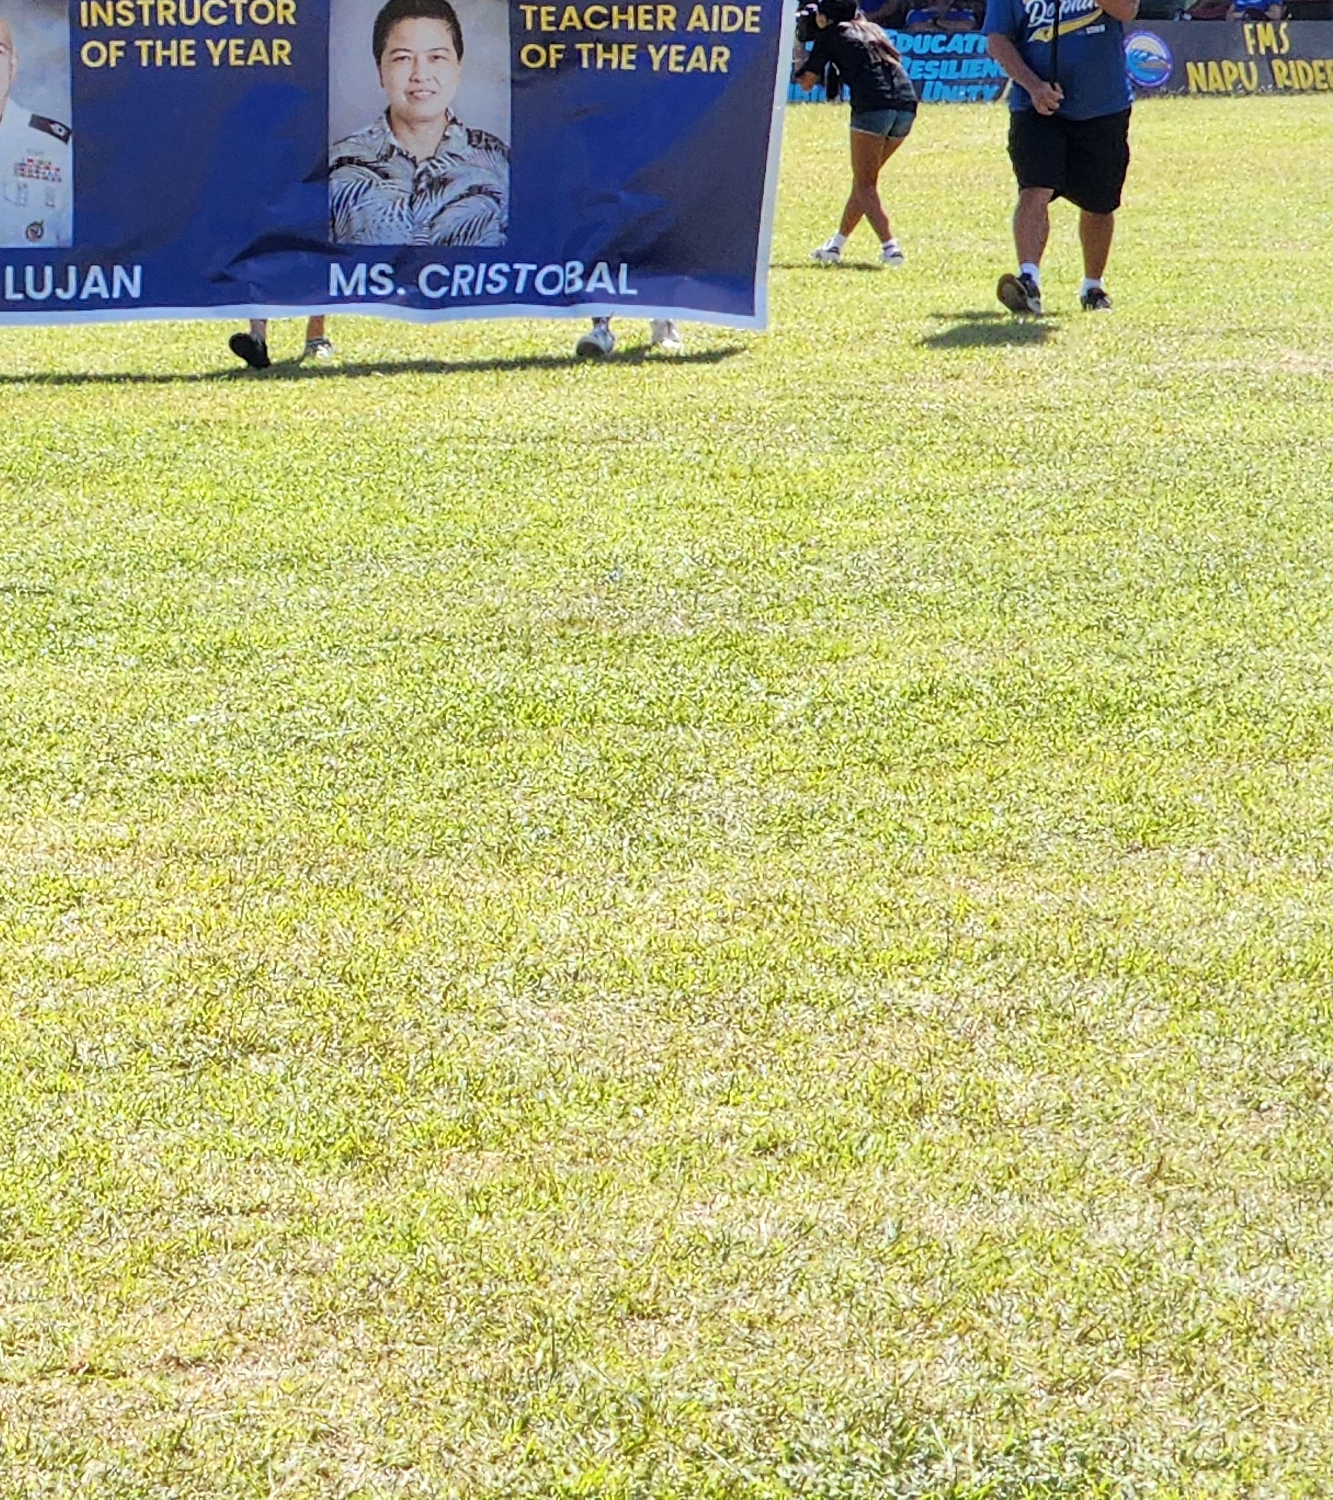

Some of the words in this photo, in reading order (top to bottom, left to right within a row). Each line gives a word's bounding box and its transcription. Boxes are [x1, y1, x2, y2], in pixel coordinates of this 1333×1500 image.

[520, 4, 677, 34] TEACHER
[686, 4, 762, 35] AIDE
[80, 40, 126, 68] OF
[135, 40, 195, 68] THE
[205, 38, 293, 67] YEAR
[1242, 21, 1291, 57] FMS
[520, 43, 565, 70] OF
[576, 43, 638, 71] THE
[647, 44, 731, 74] YEAR
[1185, 59, 1260, 94] NAPU
[5, 264, 143, 299] LUJAN
[328, 262, 406, 298] MS.
[417, 260, 638, 298] CRISTOBAL
